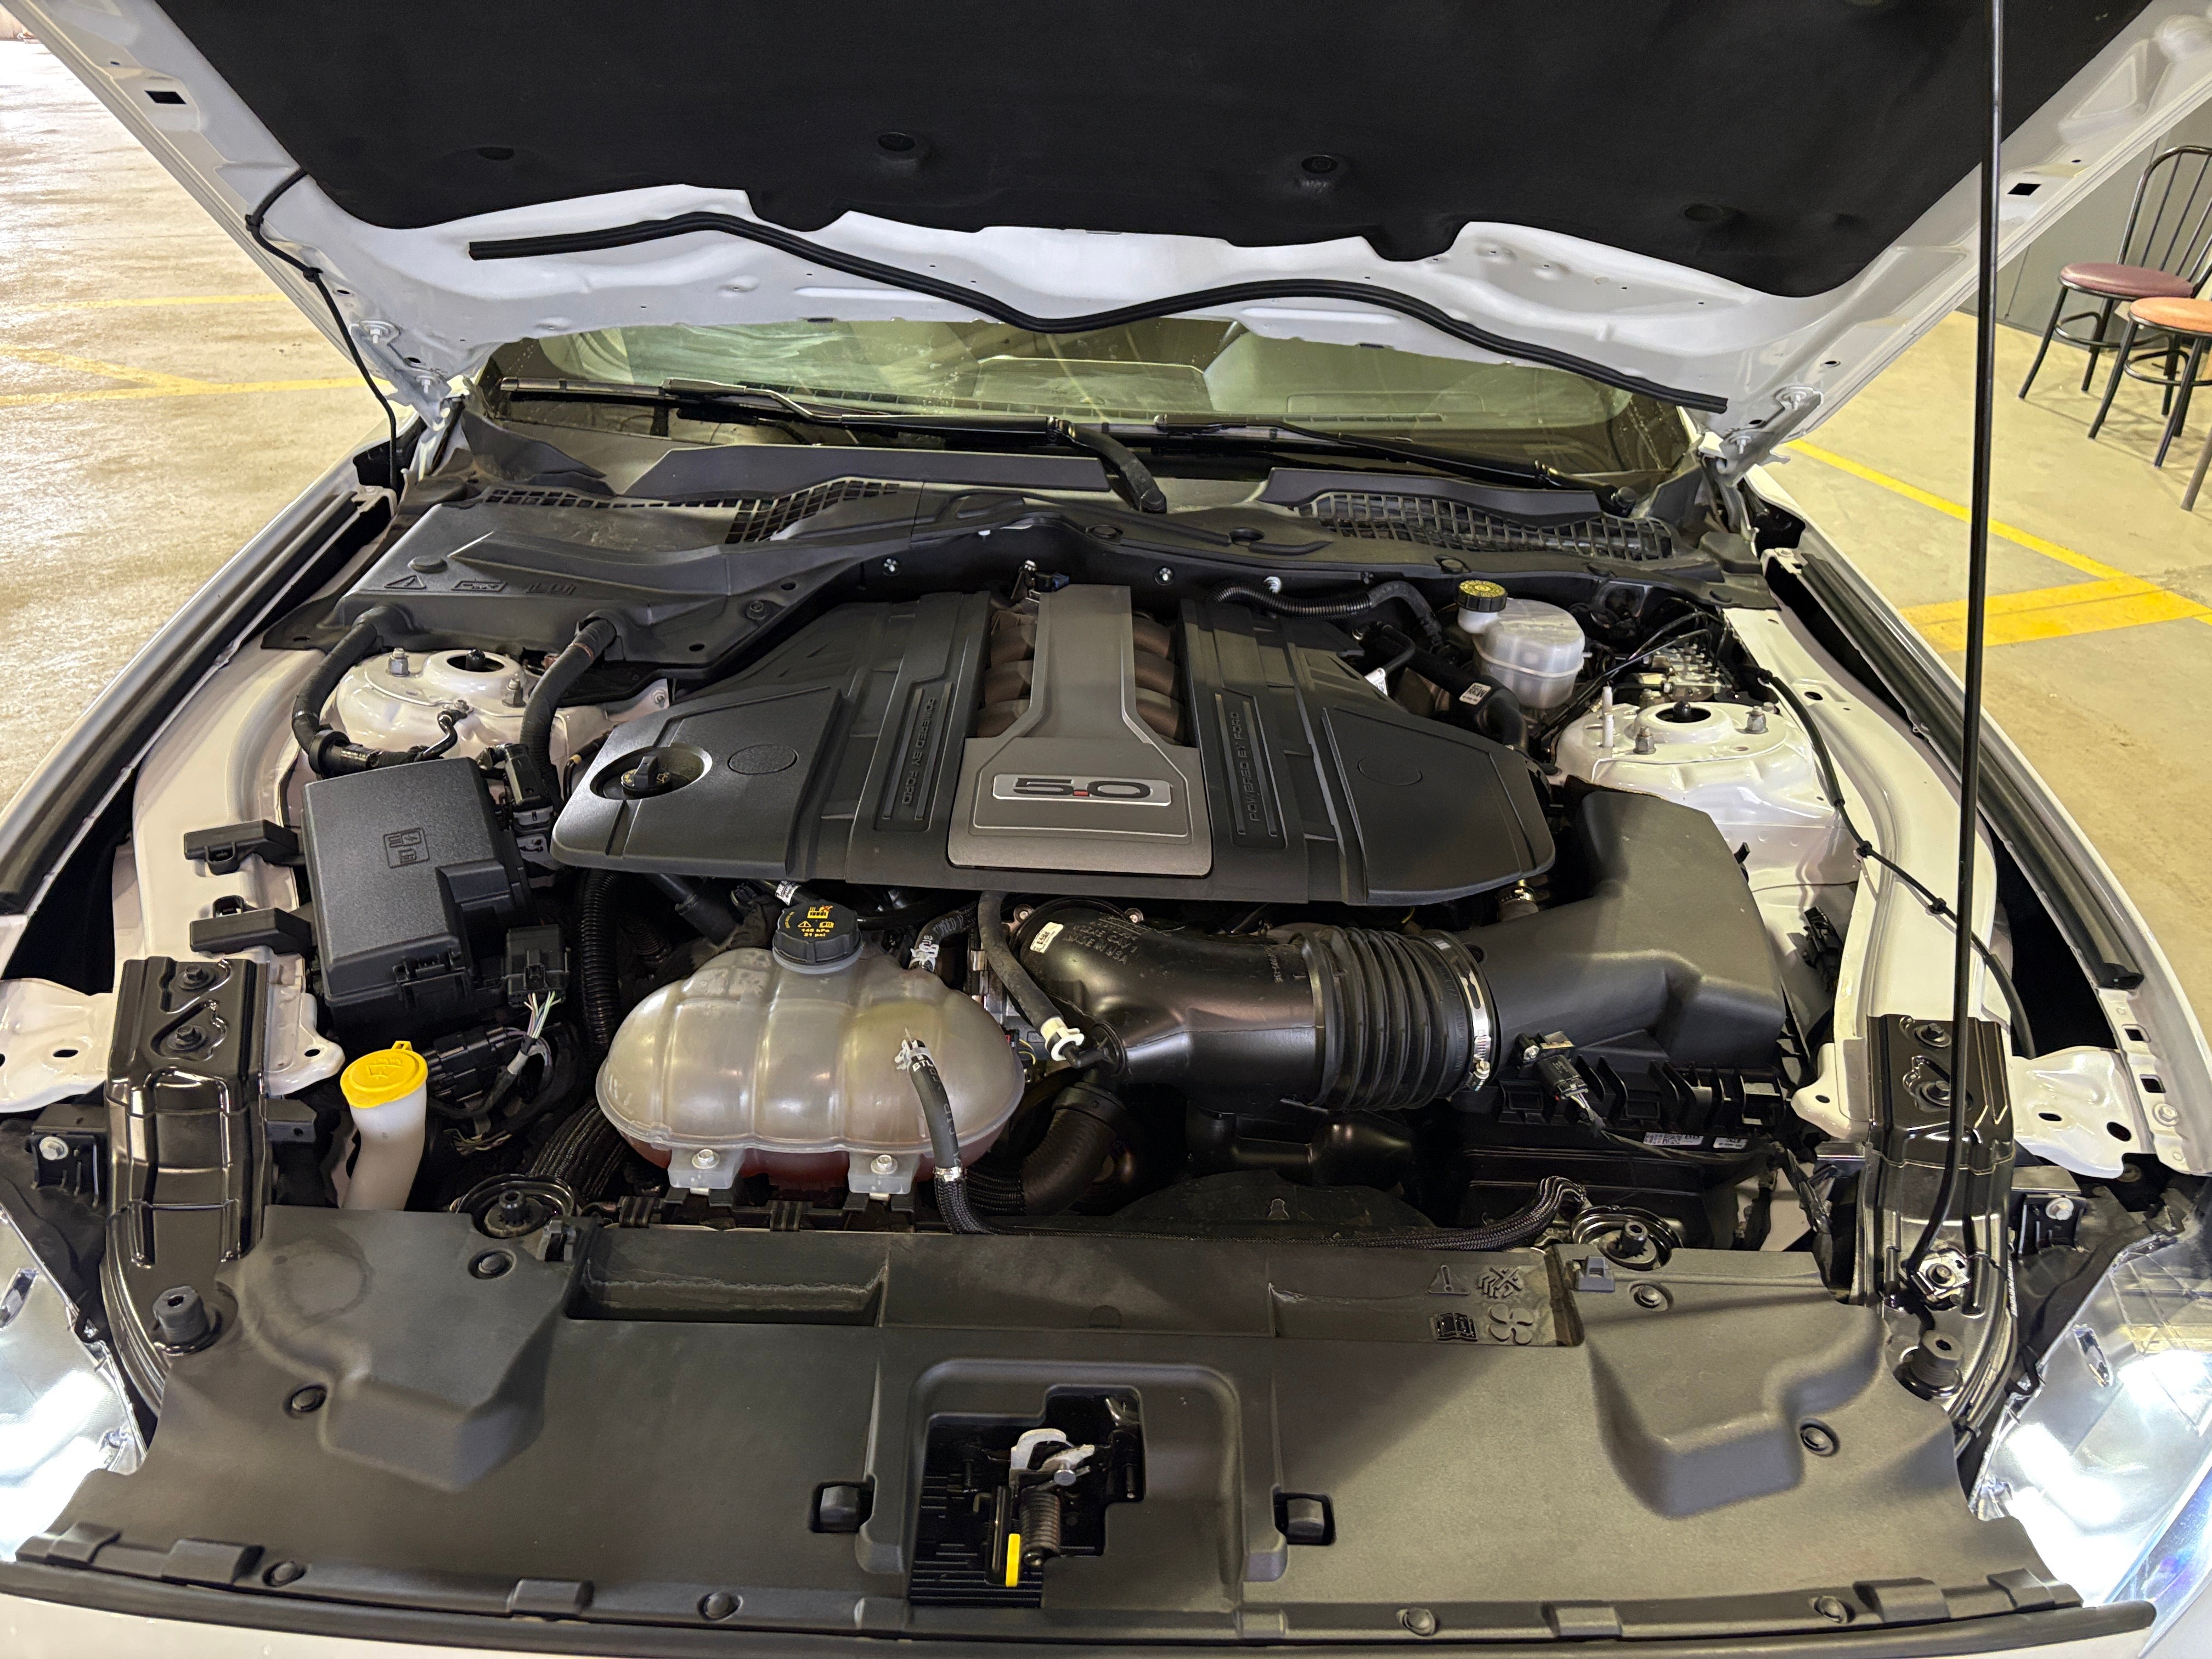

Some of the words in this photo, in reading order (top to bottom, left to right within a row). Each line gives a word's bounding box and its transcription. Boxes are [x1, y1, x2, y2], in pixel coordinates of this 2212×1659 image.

[1230, 712, 1244, 740] FORD
[911, 751, 923, 766] BY
[1235, 743, 1248, 758] BY
[902, 770, 919, 804] FORD
[1013, 777, 1151, 799] 5.0
[1239, 761, 1260, 822] POWERED
